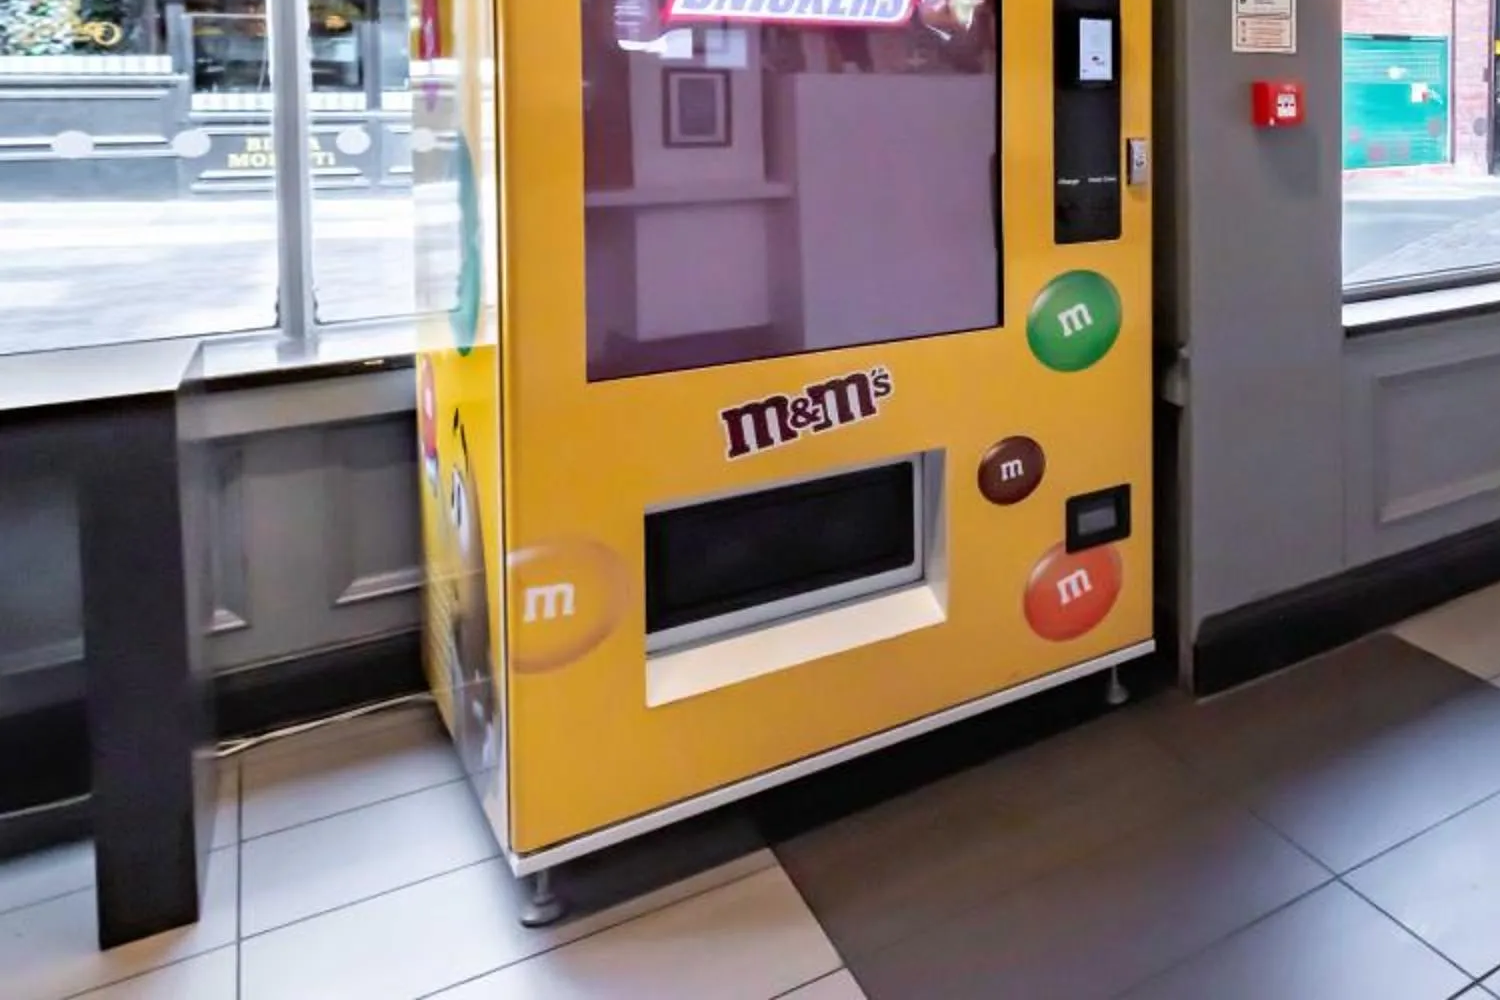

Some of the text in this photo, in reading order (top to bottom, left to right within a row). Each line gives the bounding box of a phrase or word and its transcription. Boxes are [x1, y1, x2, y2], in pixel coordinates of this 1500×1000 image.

[1058, 299, 1093, 338] m
[999, 455, 1026, 482] m
[523, 580, 576, 623] m
[1055, 566, 1093, 607] m
